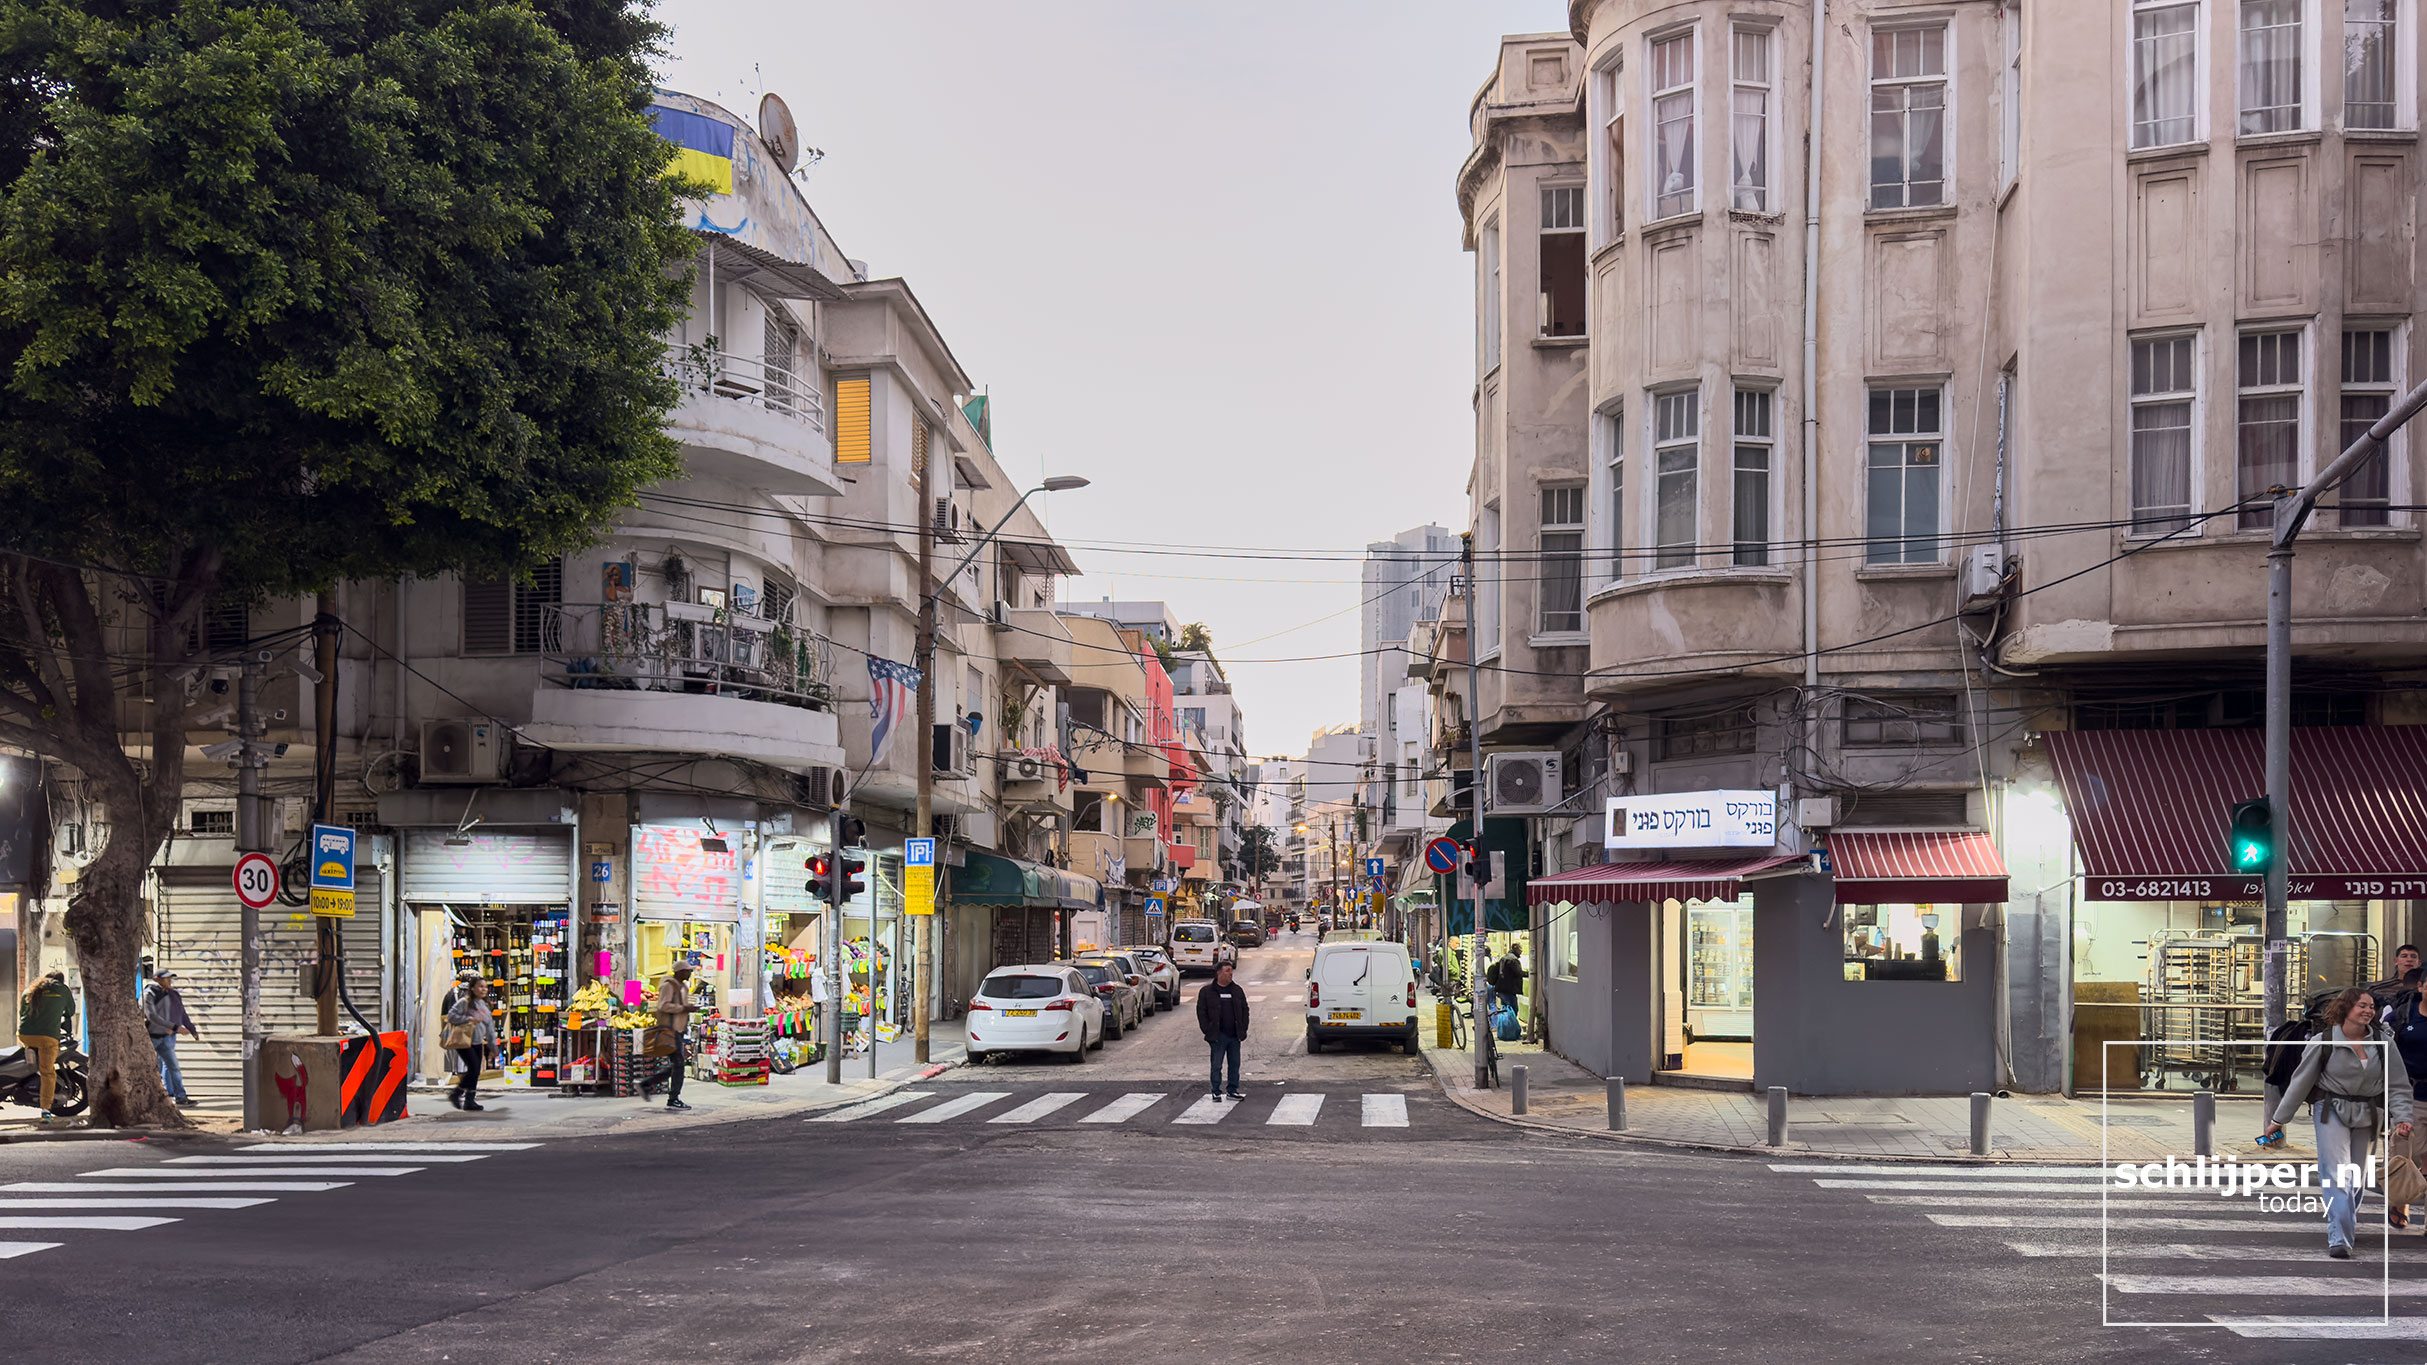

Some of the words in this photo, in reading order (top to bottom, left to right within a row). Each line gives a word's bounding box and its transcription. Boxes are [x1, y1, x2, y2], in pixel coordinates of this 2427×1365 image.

[1727, 802, 1772, 820] בורקס
[1663, 808, 1711, 836] בורקס
[242, 868, 268, 892] 30
[594, 865, 609, 878] 26
[2101, 881, 2212, 898] 03-6821413
[2391, 881, 2427, 895] ריה
[313, 896, 329, 909] 10:00
[337, 897, 353, 911] 19:00
